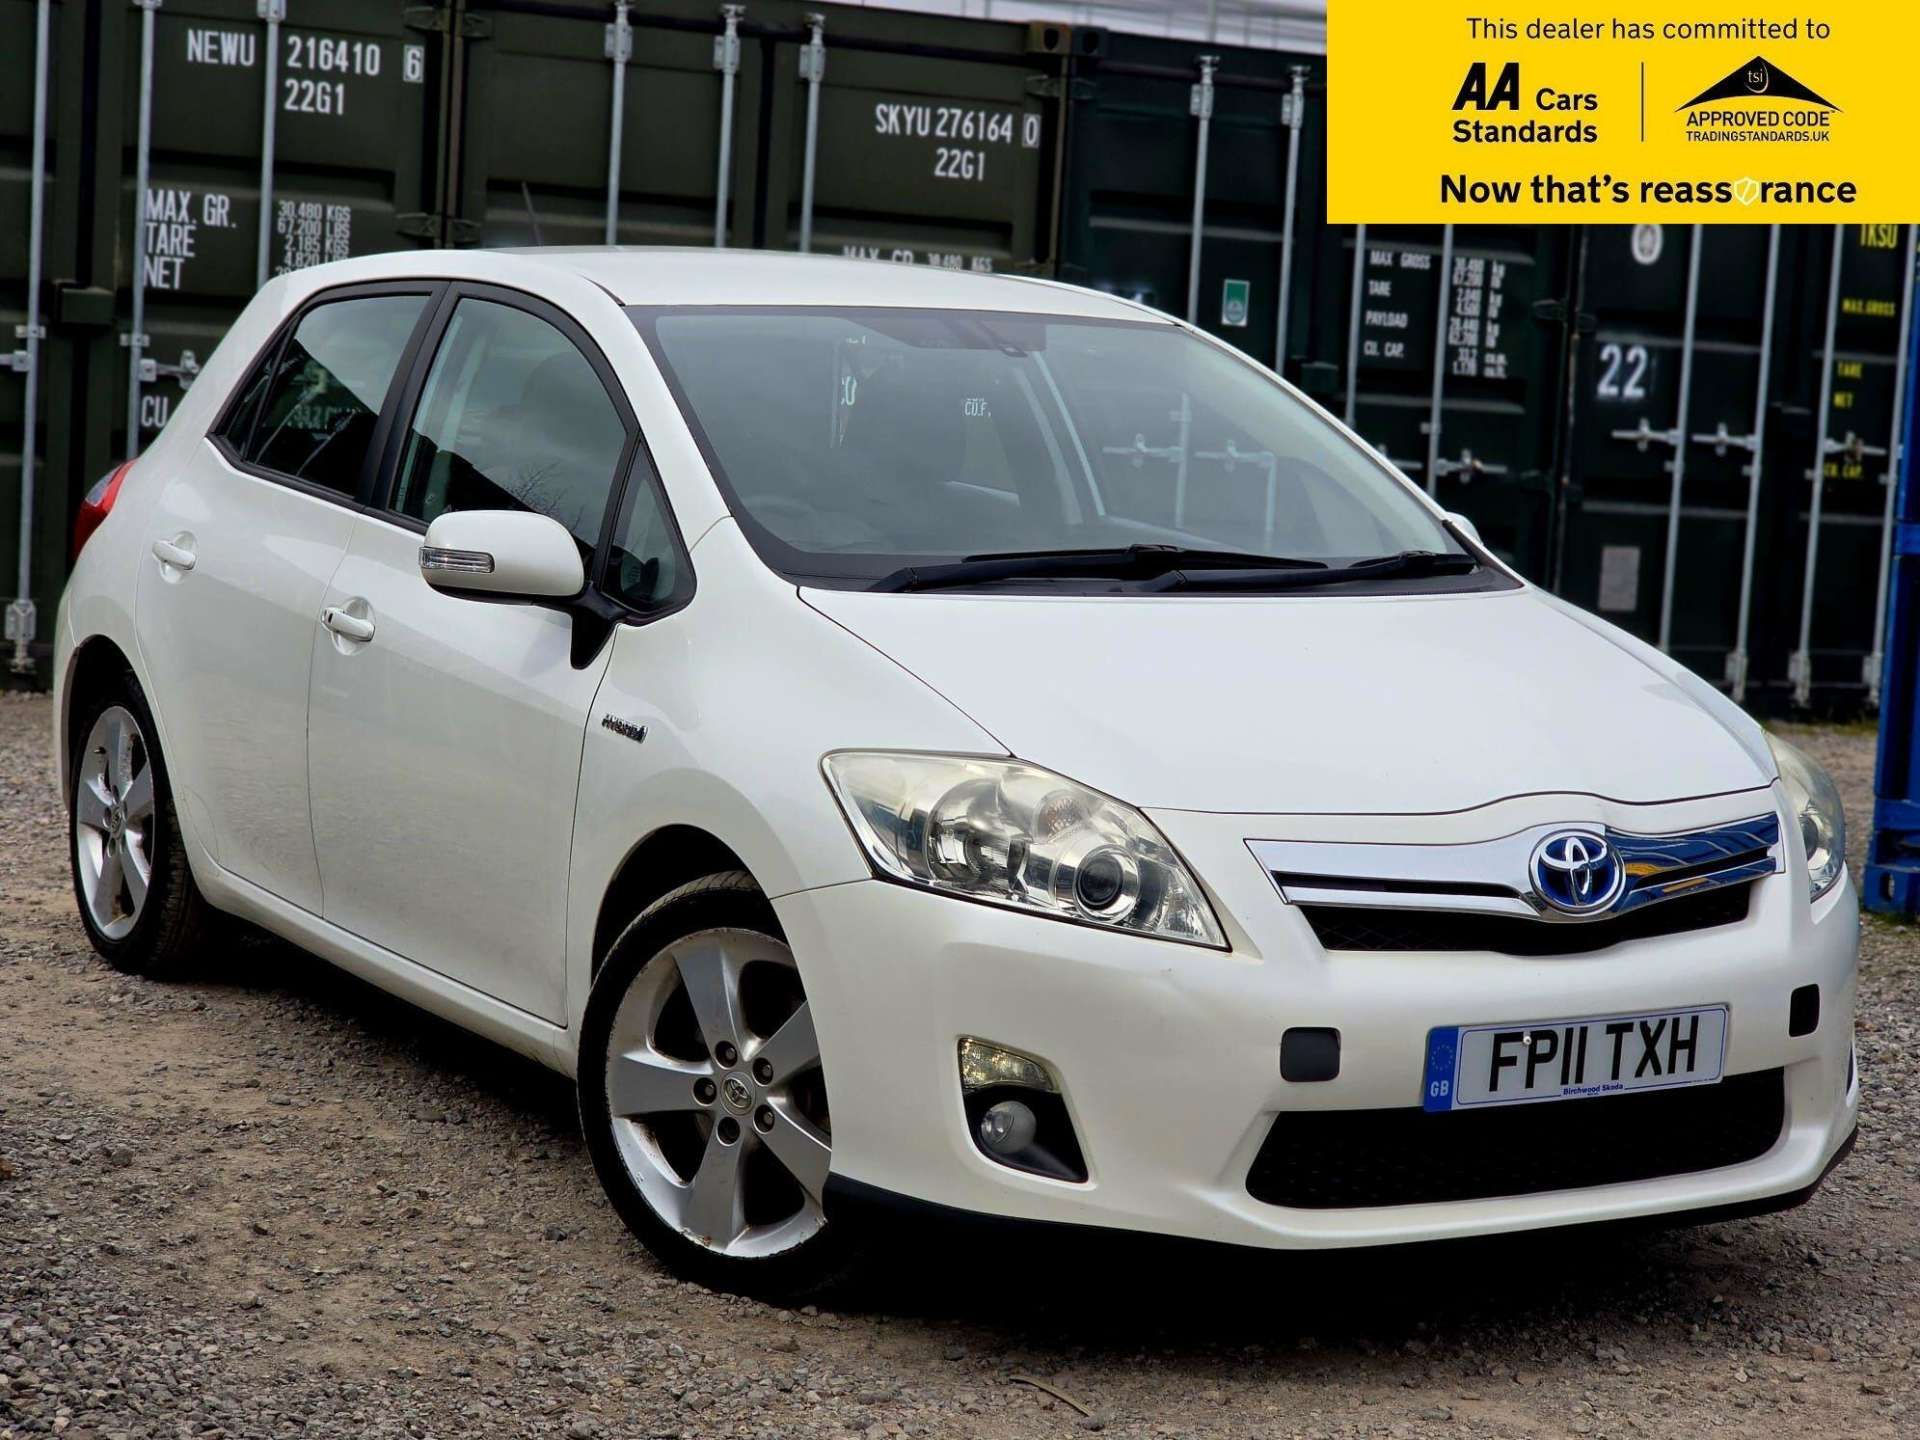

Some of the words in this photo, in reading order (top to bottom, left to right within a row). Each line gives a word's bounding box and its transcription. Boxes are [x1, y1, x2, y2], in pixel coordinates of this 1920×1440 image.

[187, 29, 256, 67] NEWU
[287, 36, 381, 77] 216410
[405, 47, 423, 81] 6
[284, 78, 345, 115] 22G1
[875, 104, 930, 136] SKYU
[934, 108, 1013, 143] 276164
[1023, 115, 1040, 147] 0
[934, 148, 986, 181] 22G1
[145, 188, 197, 224] MAX.
[203, 194, 237, 228] GR.
[145, 221, 195, 258] TARE
[1370, 250, 1392, 266] MAX
[143, 255, 185, 290] NET
[1368, 279, 1392, 297] TARE
[1365, 310, 1409, 328] PAYLOAD
[1597, 344, 1649, 399] 22
[1488, 1026, 1588, 1092] FP11
[1605, 1015, 1700, 1080] TXH
[1429, 1080, 1450, 1097] GB
